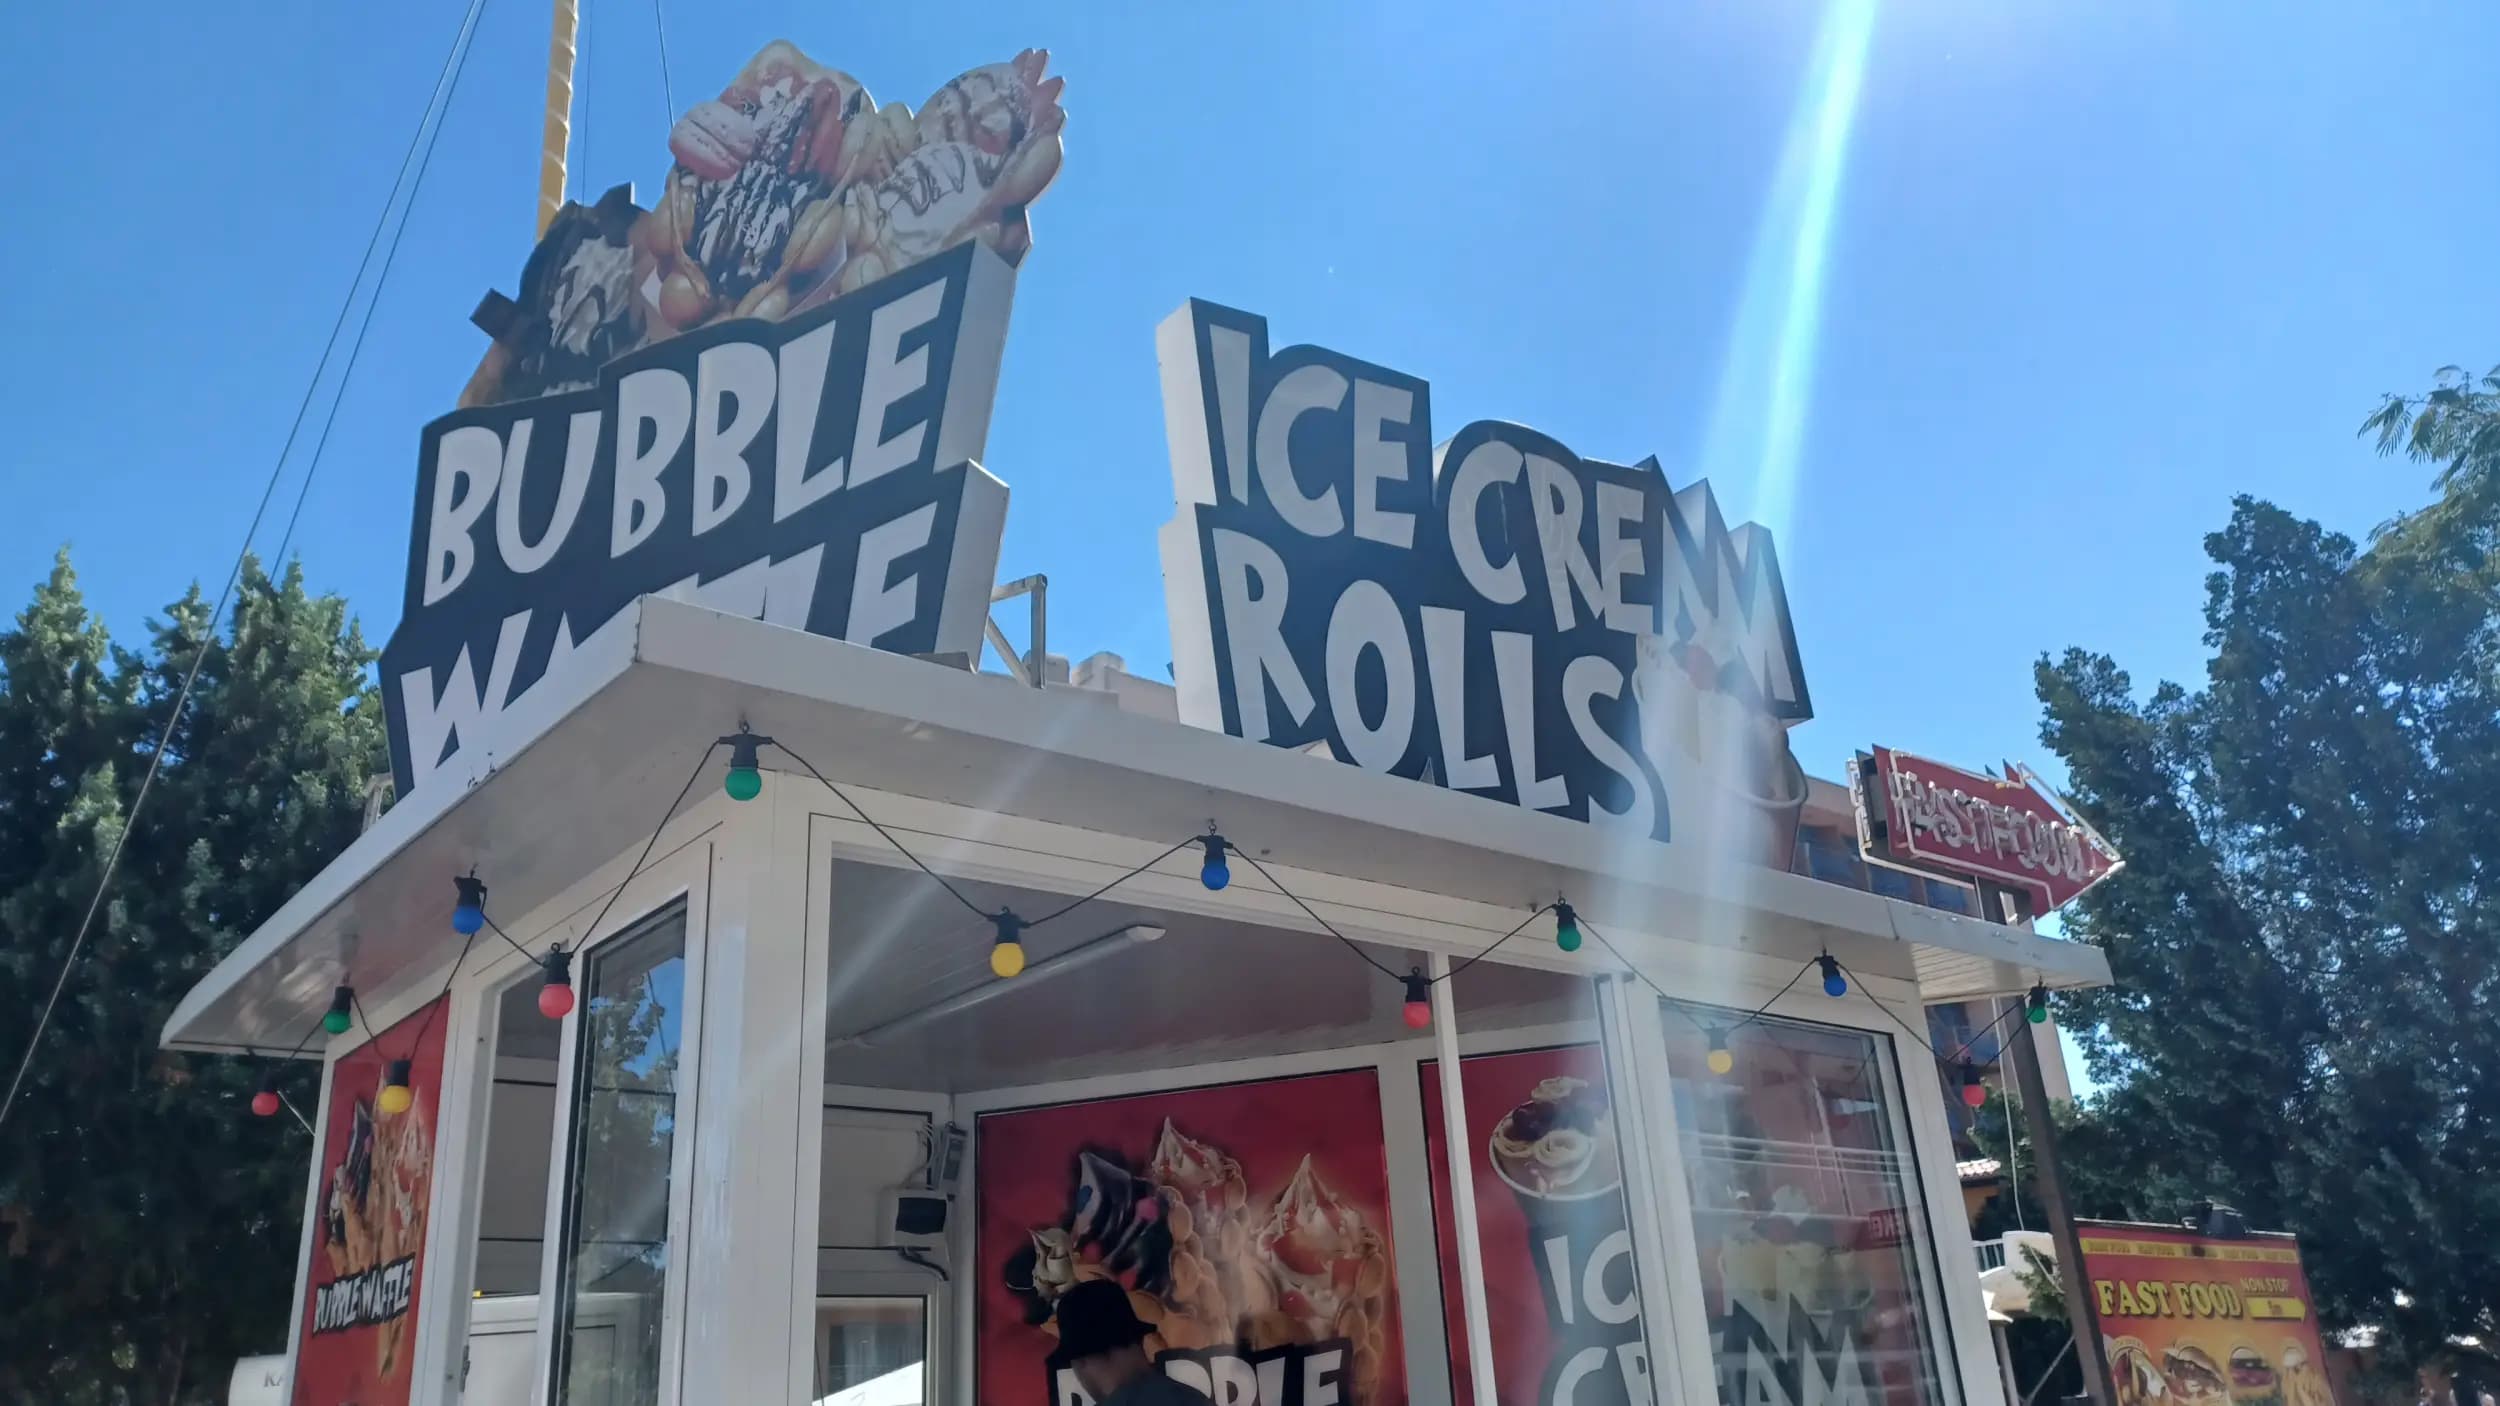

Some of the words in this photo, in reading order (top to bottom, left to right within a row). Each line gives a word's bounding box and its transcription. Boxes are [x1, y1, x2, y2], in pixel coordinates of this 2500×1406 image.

[422, 275, 948, 607] BUBBLE
[1208, 322, 1418, 551] ICE
[1446, 439, 1797, 703] CREAM
[1211, 526, 1660, 840] ROLLS
[361, 1257, 414, 1320] WAFFLE
[1543, 1229, 1638, 1325] IC
[2093, 1280, 2172, 1316] FAST
[2170, 1281, 2242, 1317] FOOD
